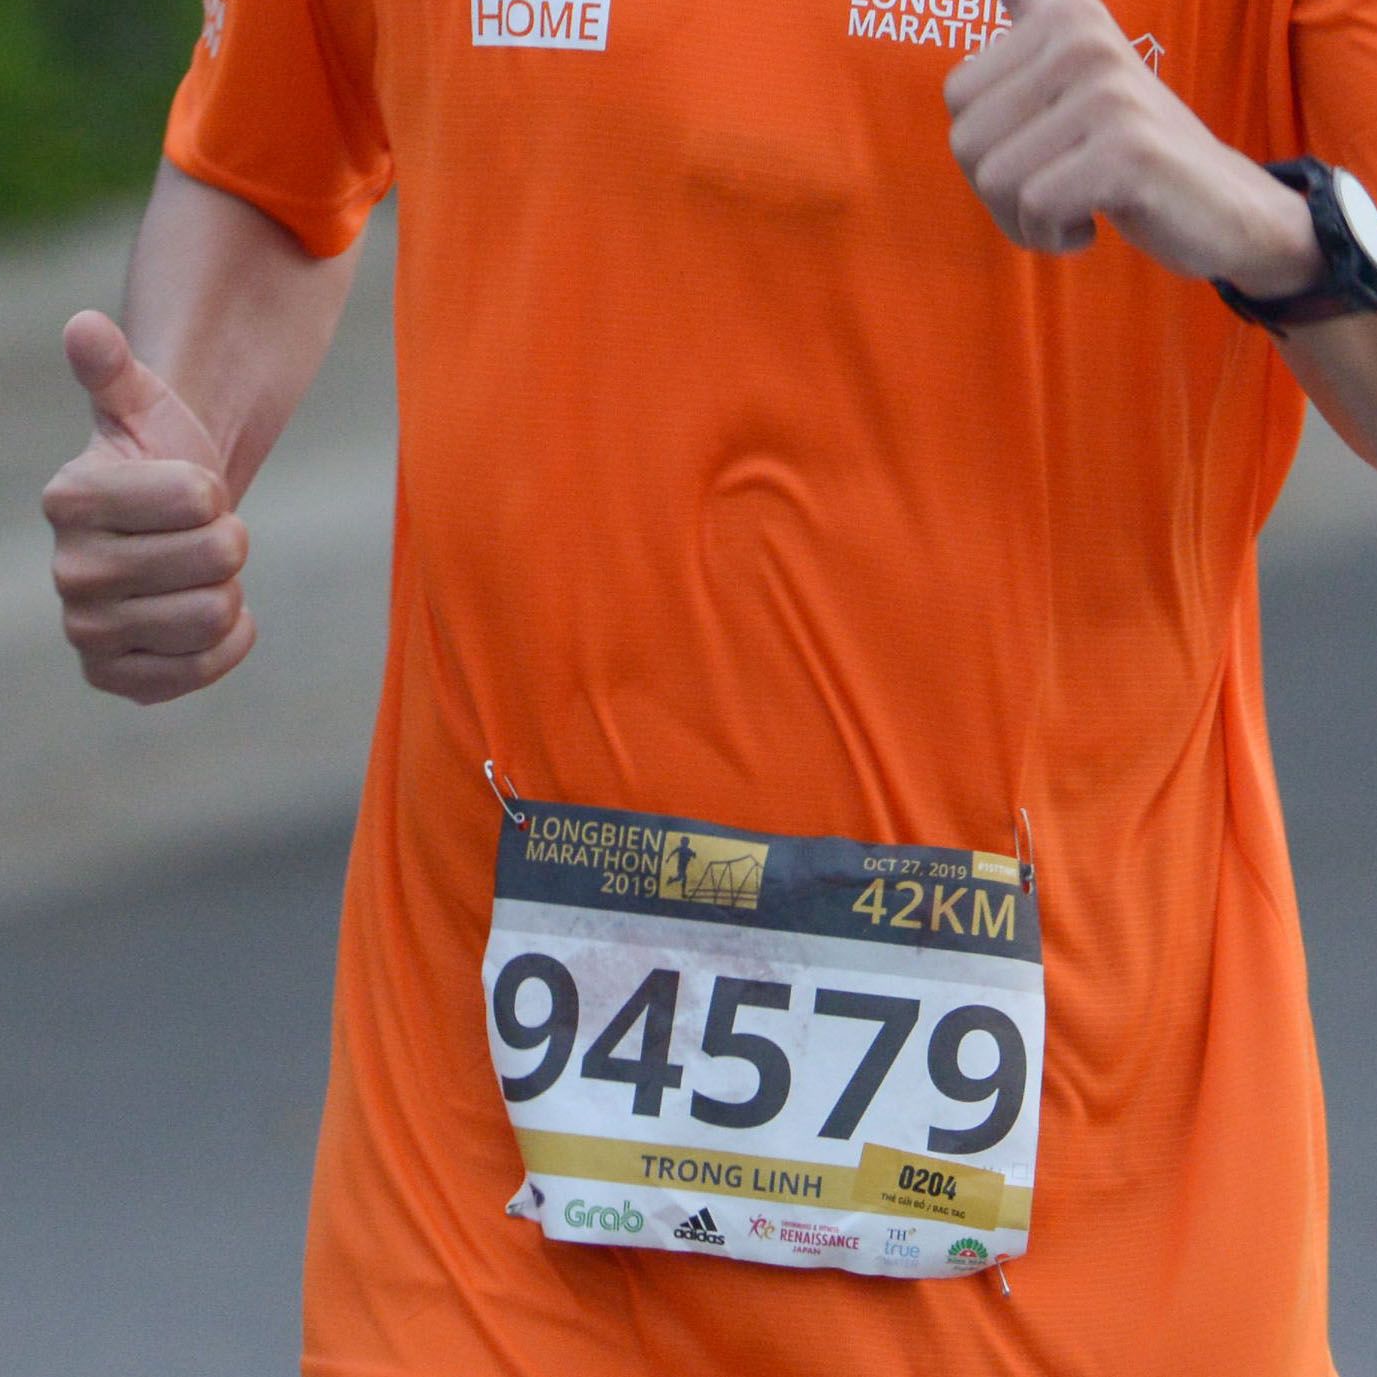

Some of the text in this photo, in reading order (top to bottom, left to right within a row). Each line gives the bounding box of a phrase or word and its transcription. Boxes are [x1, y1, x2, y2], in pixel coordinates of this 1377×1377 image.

[848, 7, 1010, 53] MARATH
[529, 815, 662, 852] LONGBIEN
[526, 840, 659, 874] MARATHON
[863, 857, 897, 872] OCT
[928, 862, 967, 880] 2019
[600, 871, 657, 898] 2019
[852, 878, 1015, 941] 42KM
[493, 952, 1027, 1155] 94579
[641, 1154, 823, 1198] TRONG LINH
[898, 1165, 957, 1201] 0204
[564, 1199, 644, 1233] Grab
[674, 1227, 725, 1245] adidas
[780, 1228, 860, 1250] RENAISSANCE
[792, 1245, 821, 1255] JAPAN
[884, 1241, 920, 1258] true
[888, 1228, 907, 1240] TH
